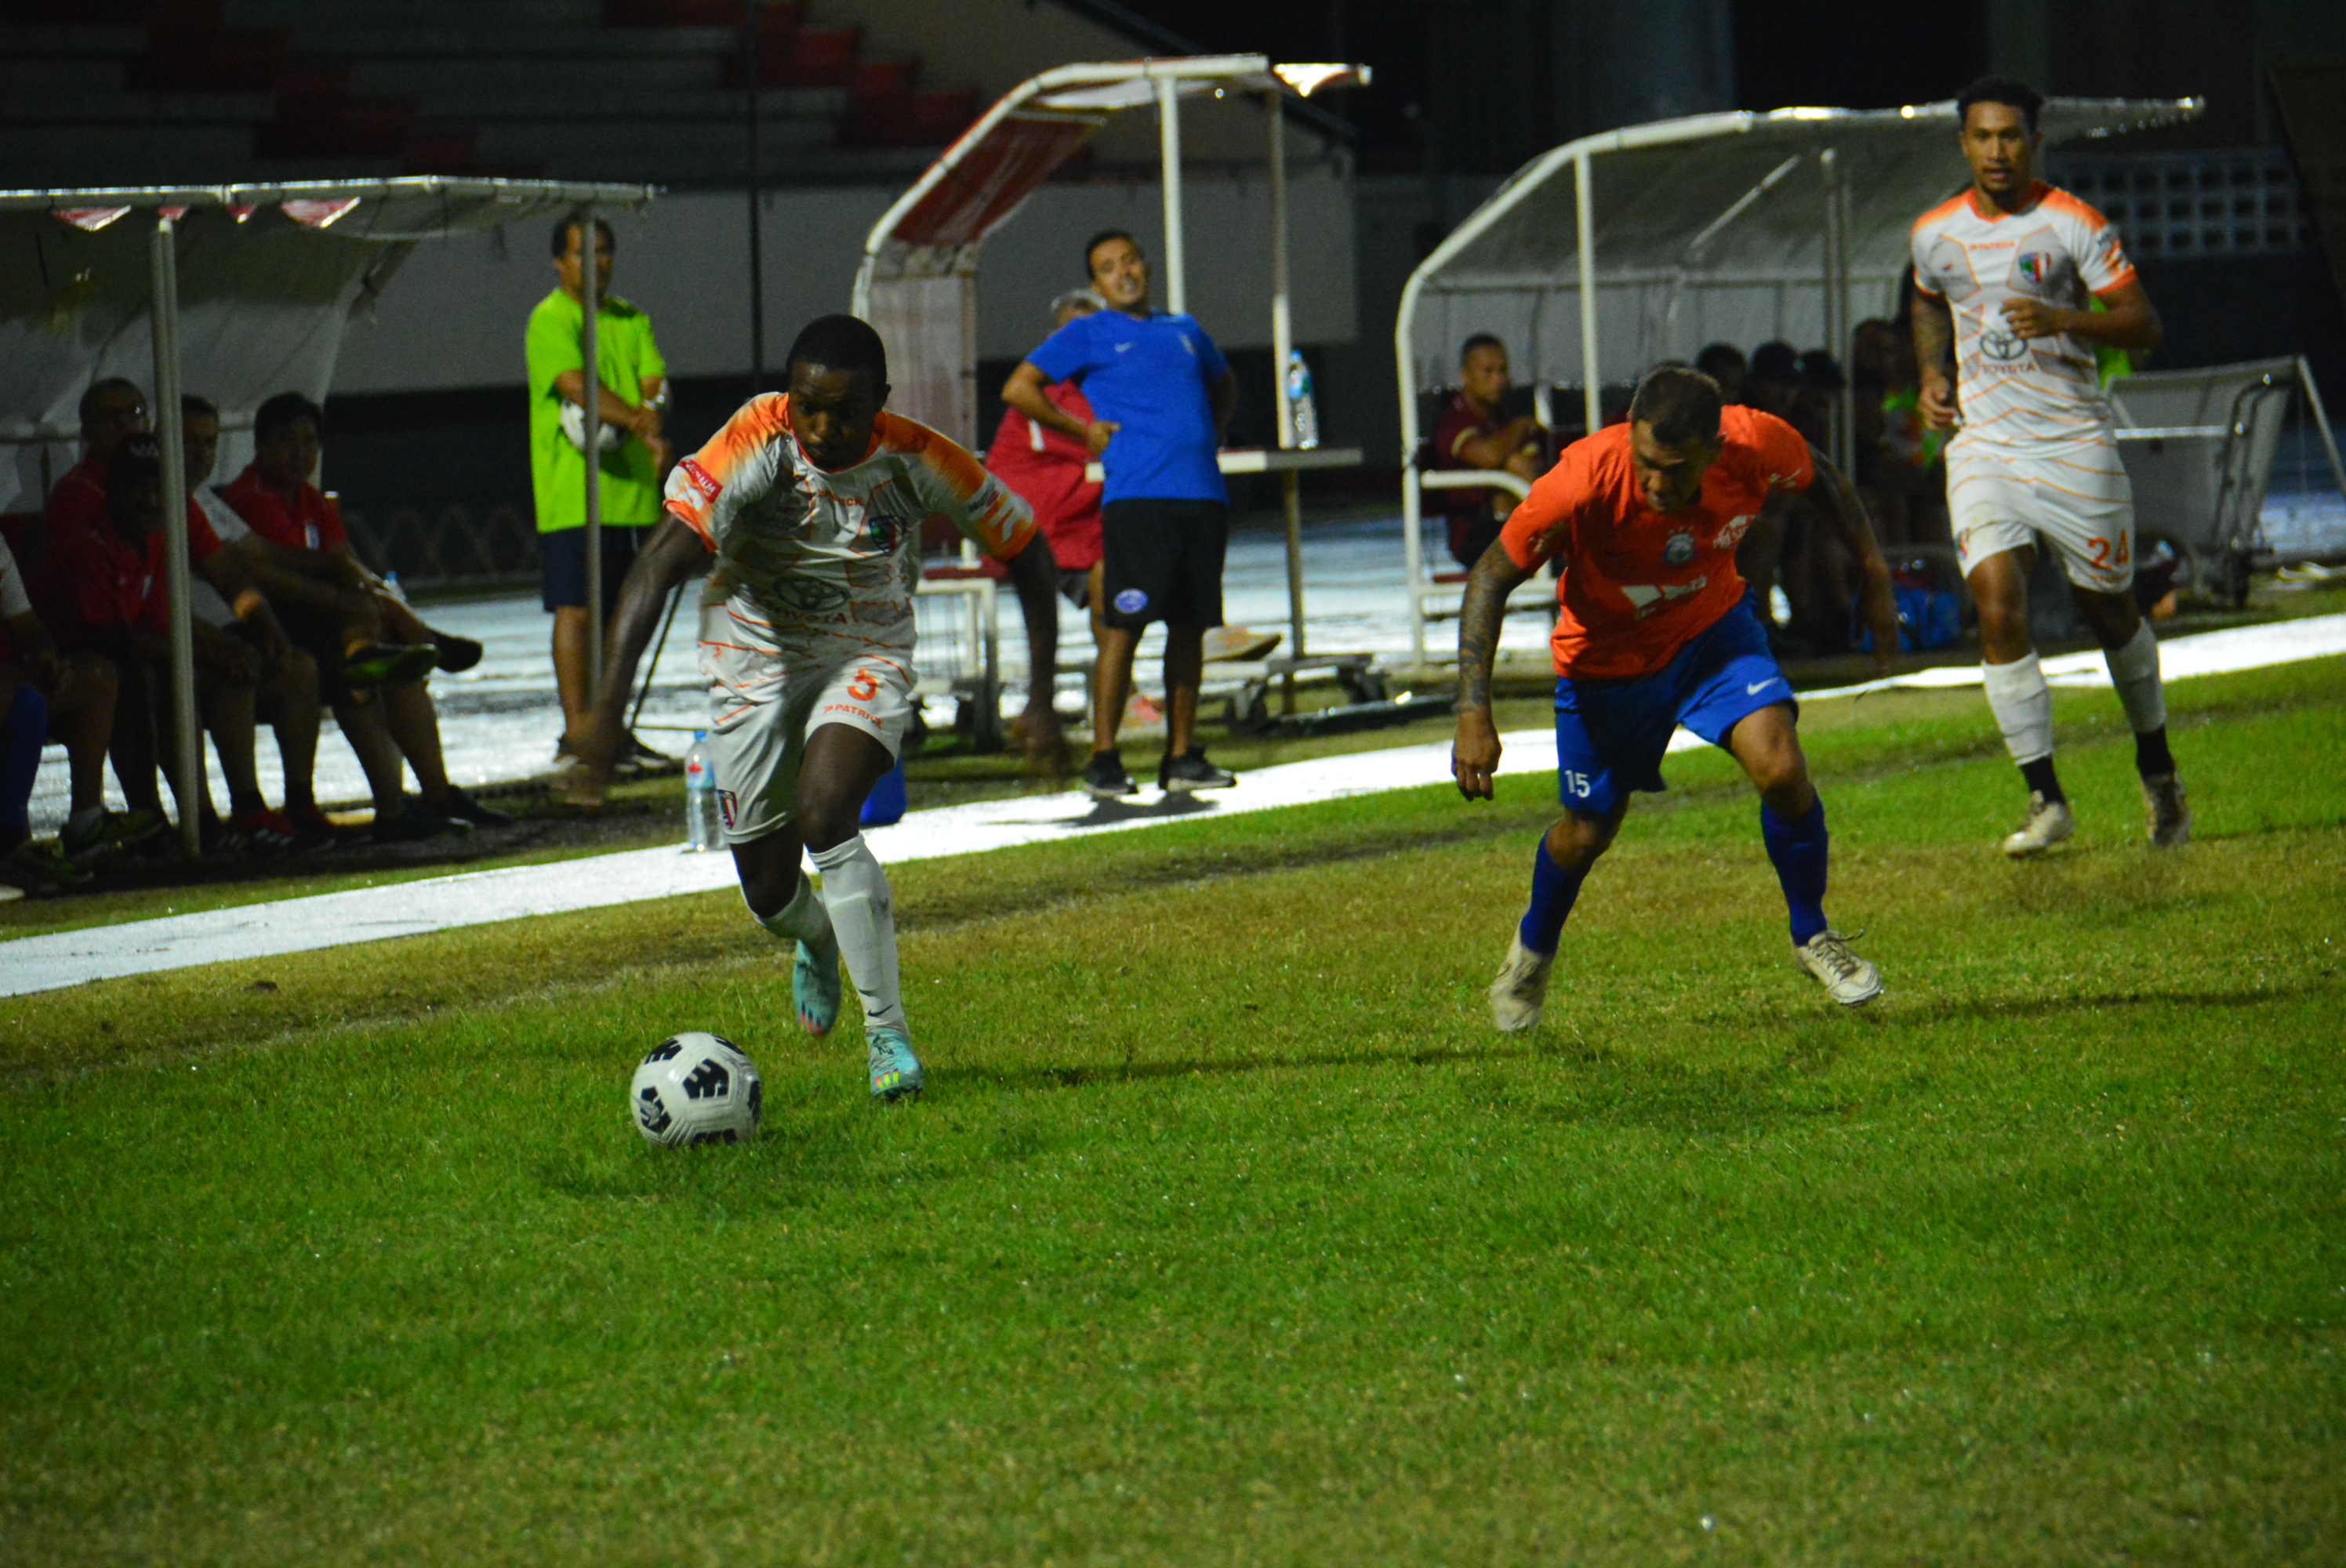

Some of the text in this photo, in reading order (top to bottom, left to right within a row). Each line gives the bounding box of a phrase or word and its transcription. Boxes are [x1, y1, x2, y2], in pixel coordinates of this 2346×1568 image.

[1983, 363, 2037, 374] TOYOTA
[2088, 529, 2130, 572] 24
[848, 668, 877, 701] 5
[835, 703, 884, 728] PATRICK
[1564, 770, 1591, 798] 15
